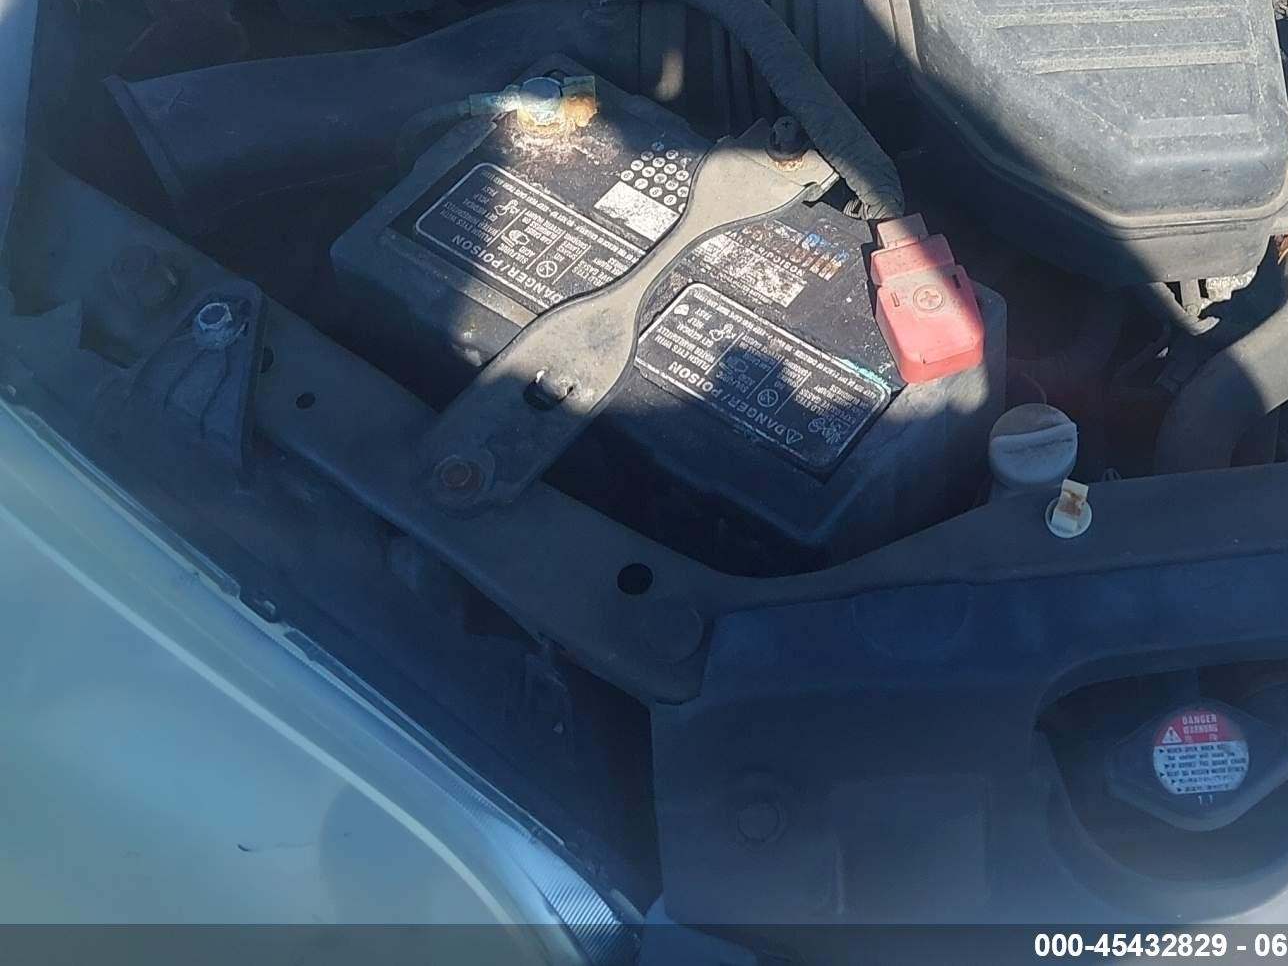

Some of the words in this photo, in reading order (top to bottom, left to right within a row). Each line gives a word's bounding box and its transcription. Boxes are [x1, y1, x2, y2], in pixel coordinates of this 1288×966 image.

[449, 233, 564, 304] DANGER/POISON
[666, 360, 787, 435] DANGER/POISON
[1182, 714, 1217, 725] DANGER
